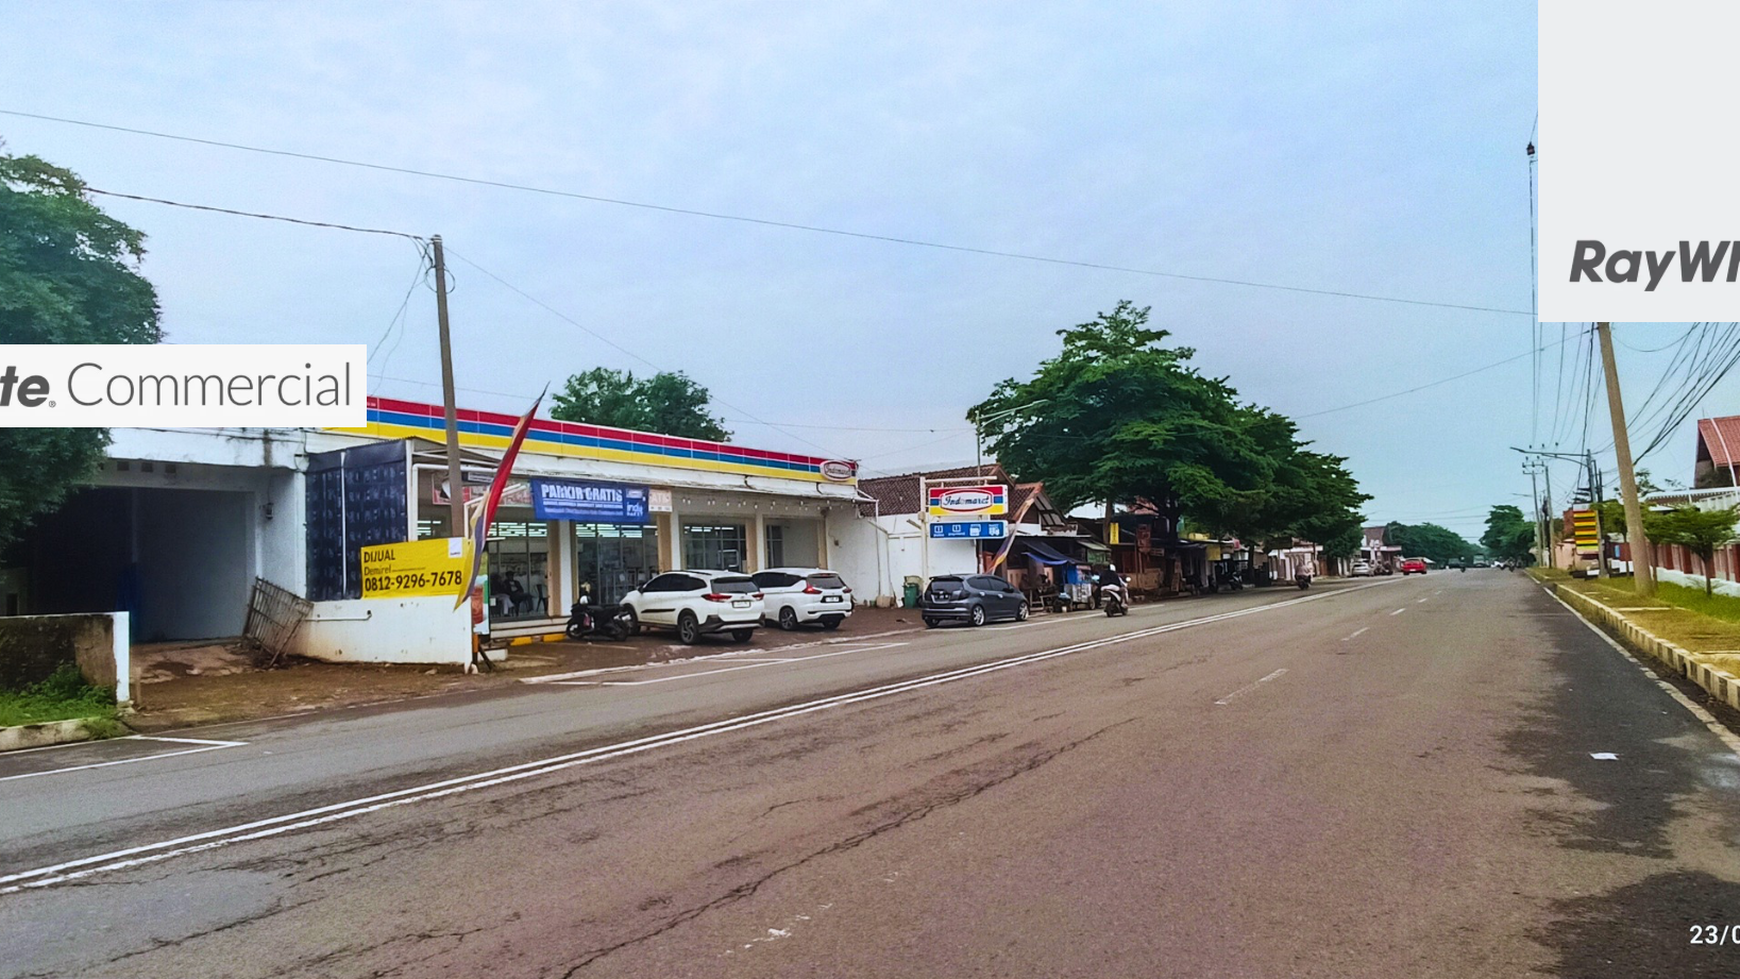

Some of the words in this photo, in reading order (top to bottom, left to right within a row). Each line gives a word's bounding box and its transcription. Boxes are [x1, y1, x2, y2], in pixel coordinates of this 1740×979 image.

[541, 484, 583, 500] PARKIR
[584, 487, 623, 502] GRATIS
[943, 495, 989, 506] Indomaret
[363, 549, 396, 563] DIJUAL
[364, 564, 392, 576] Demirel
[364, 570, 462, 592] 0812-9296-7678
